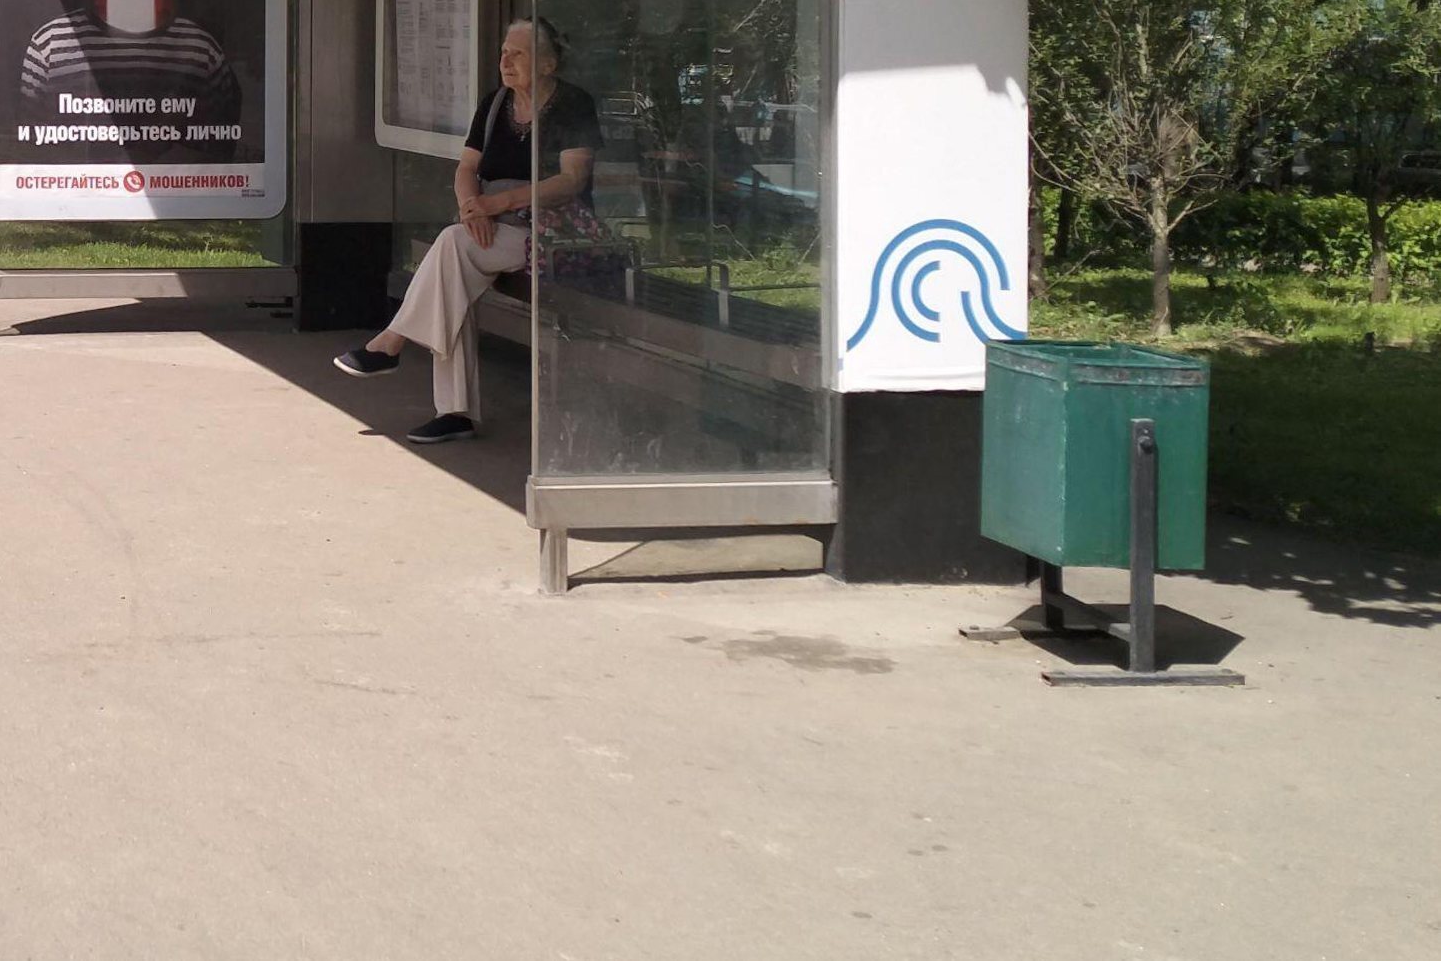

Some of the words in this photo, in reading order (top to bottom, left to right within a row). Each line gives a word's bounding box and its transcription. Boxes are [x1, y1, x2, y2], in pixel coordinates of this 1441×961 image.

[58, 93, 156, 114] Позвоните
[160, 97, 196, 118] ему
[18, 125, 30, 141] и
[34, 124, 181, 145] удостоверьтесь
[185, 124, 242, 140] лично
[16, 173, 119, 189] ОСТЕРЕГАЙТЕСЬ
[149, 175, 249, 188] МОШЕННИКОВ!
